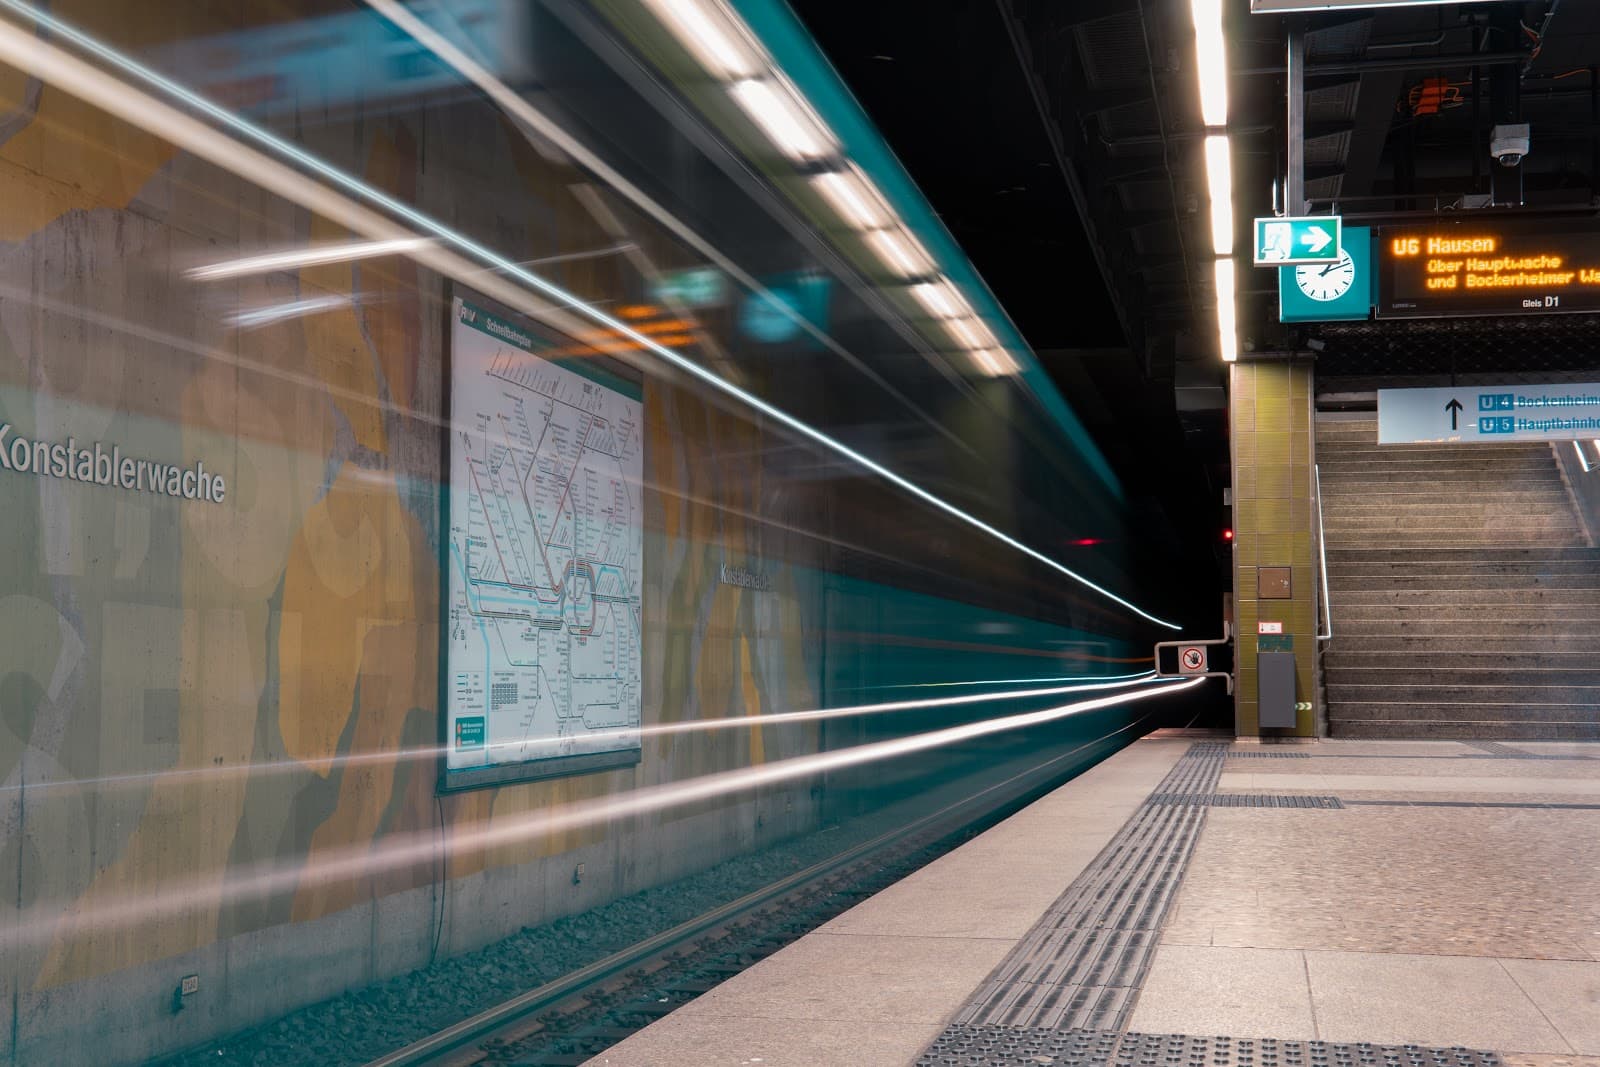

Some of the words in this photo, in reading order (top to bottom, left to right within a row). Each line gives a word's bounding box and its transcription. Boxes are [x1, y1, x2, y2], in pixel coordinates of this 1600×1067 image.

[1393, 238, 1420, 256] U6
[1427, 237, 1495, 254] Hausen
[1466, 255, 1562, 273] Hauptwache
[1427, 274, 1457, 289] und
[1465, 271, 1575, 288] Bockenheimer
[1522, 299, 1542, 308] Gleis
[1544, 295, 1559, 307] D1
[1481, 397, 1494, 409] U
[1501, 396, 1509, 408] 4
[1518, 393, 1600, 408] Bockenheim
[1482, 419, 1494, 432] U
[1502, 418, 1510, 430] 5
[0, 423, 226, 503] Konstablerwache
[720, 562, 769, 592] Konstablerwac
